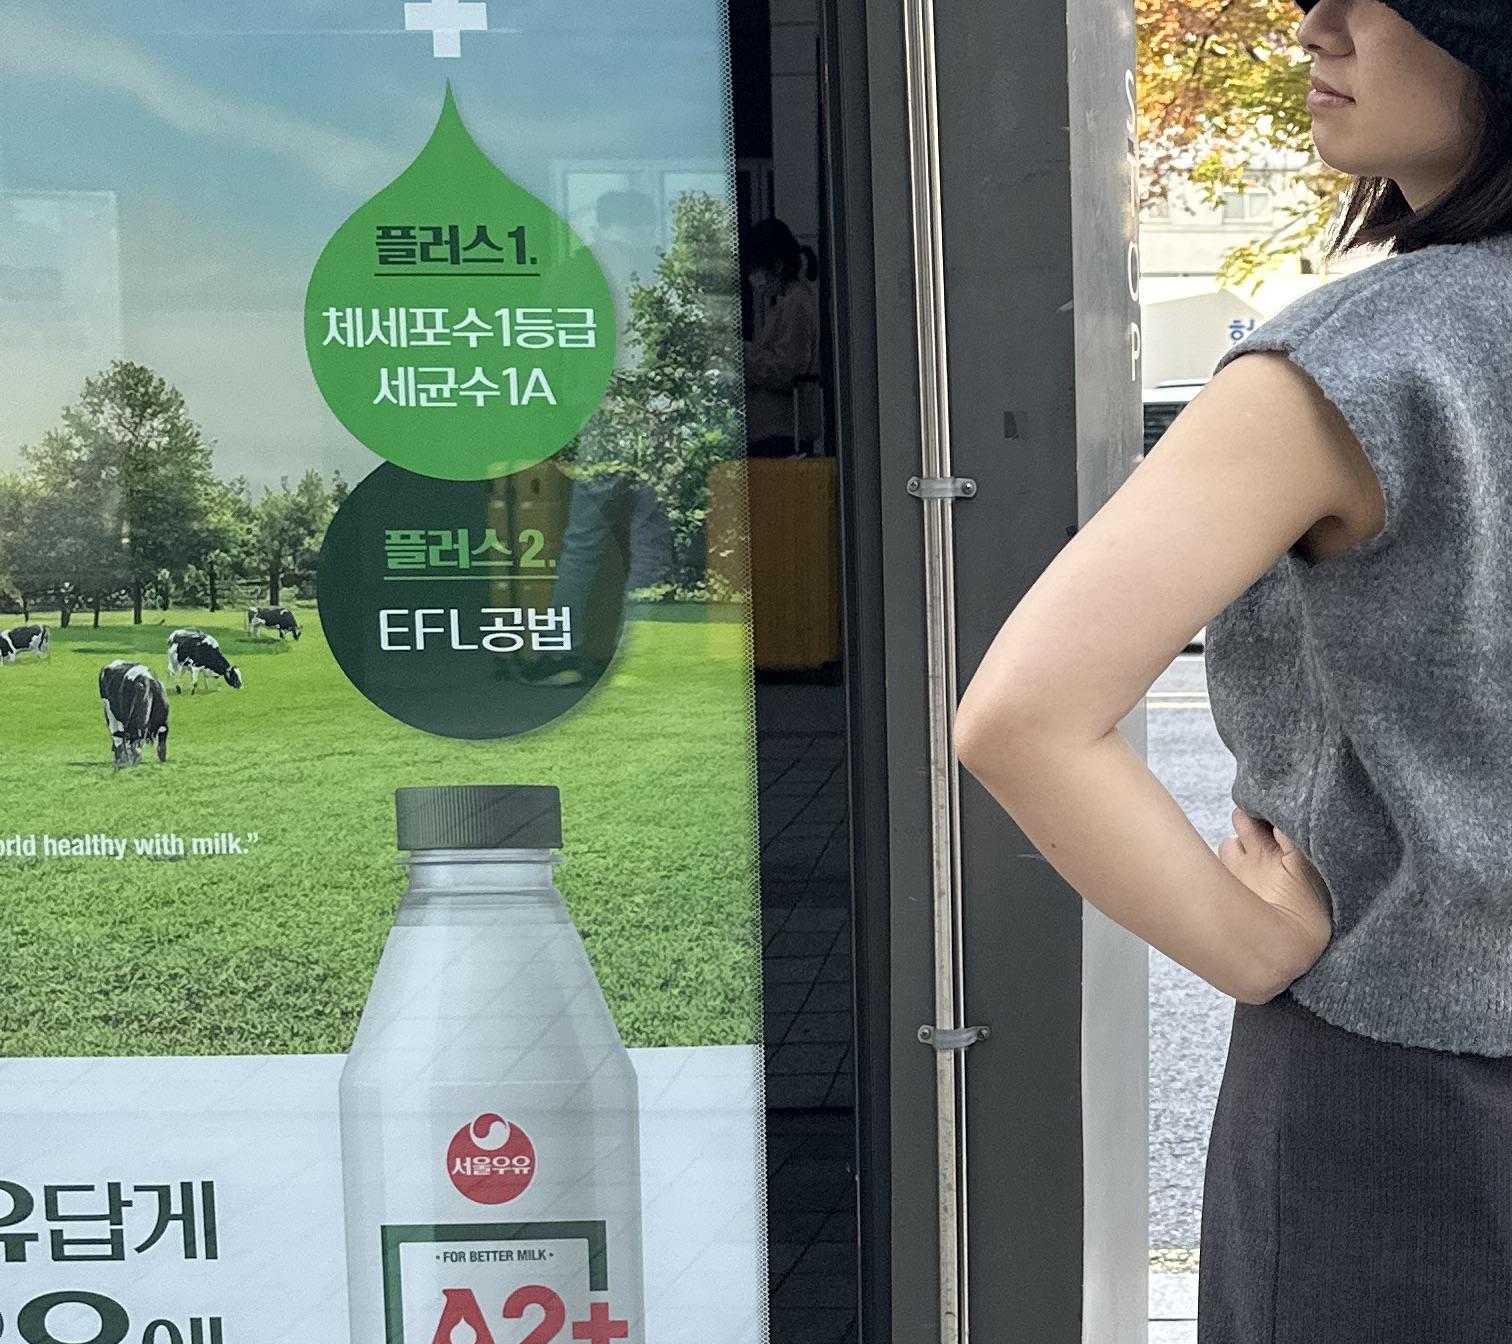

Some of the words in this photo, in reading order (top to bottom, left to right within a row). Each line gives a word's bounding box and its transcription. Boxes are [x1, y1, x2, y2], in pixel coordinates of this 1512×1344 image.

[1124, 69, 1142, 381] STOP
[322, 307, 597, 349] 체세포수1등급
[372, 367, 557, 407] 세균수1A
[379, 607, 573, 652] EFL공법
[43, 834, 126, 860] healthy
[135, 833, 184, 855] with
[452, 1156, 531, 1176] 서울우유
[443, 1251, 467, 1263] FOR
[470, 1250, 514, 1263] BETTER
[517, 1248, 547, 1261] MILK
